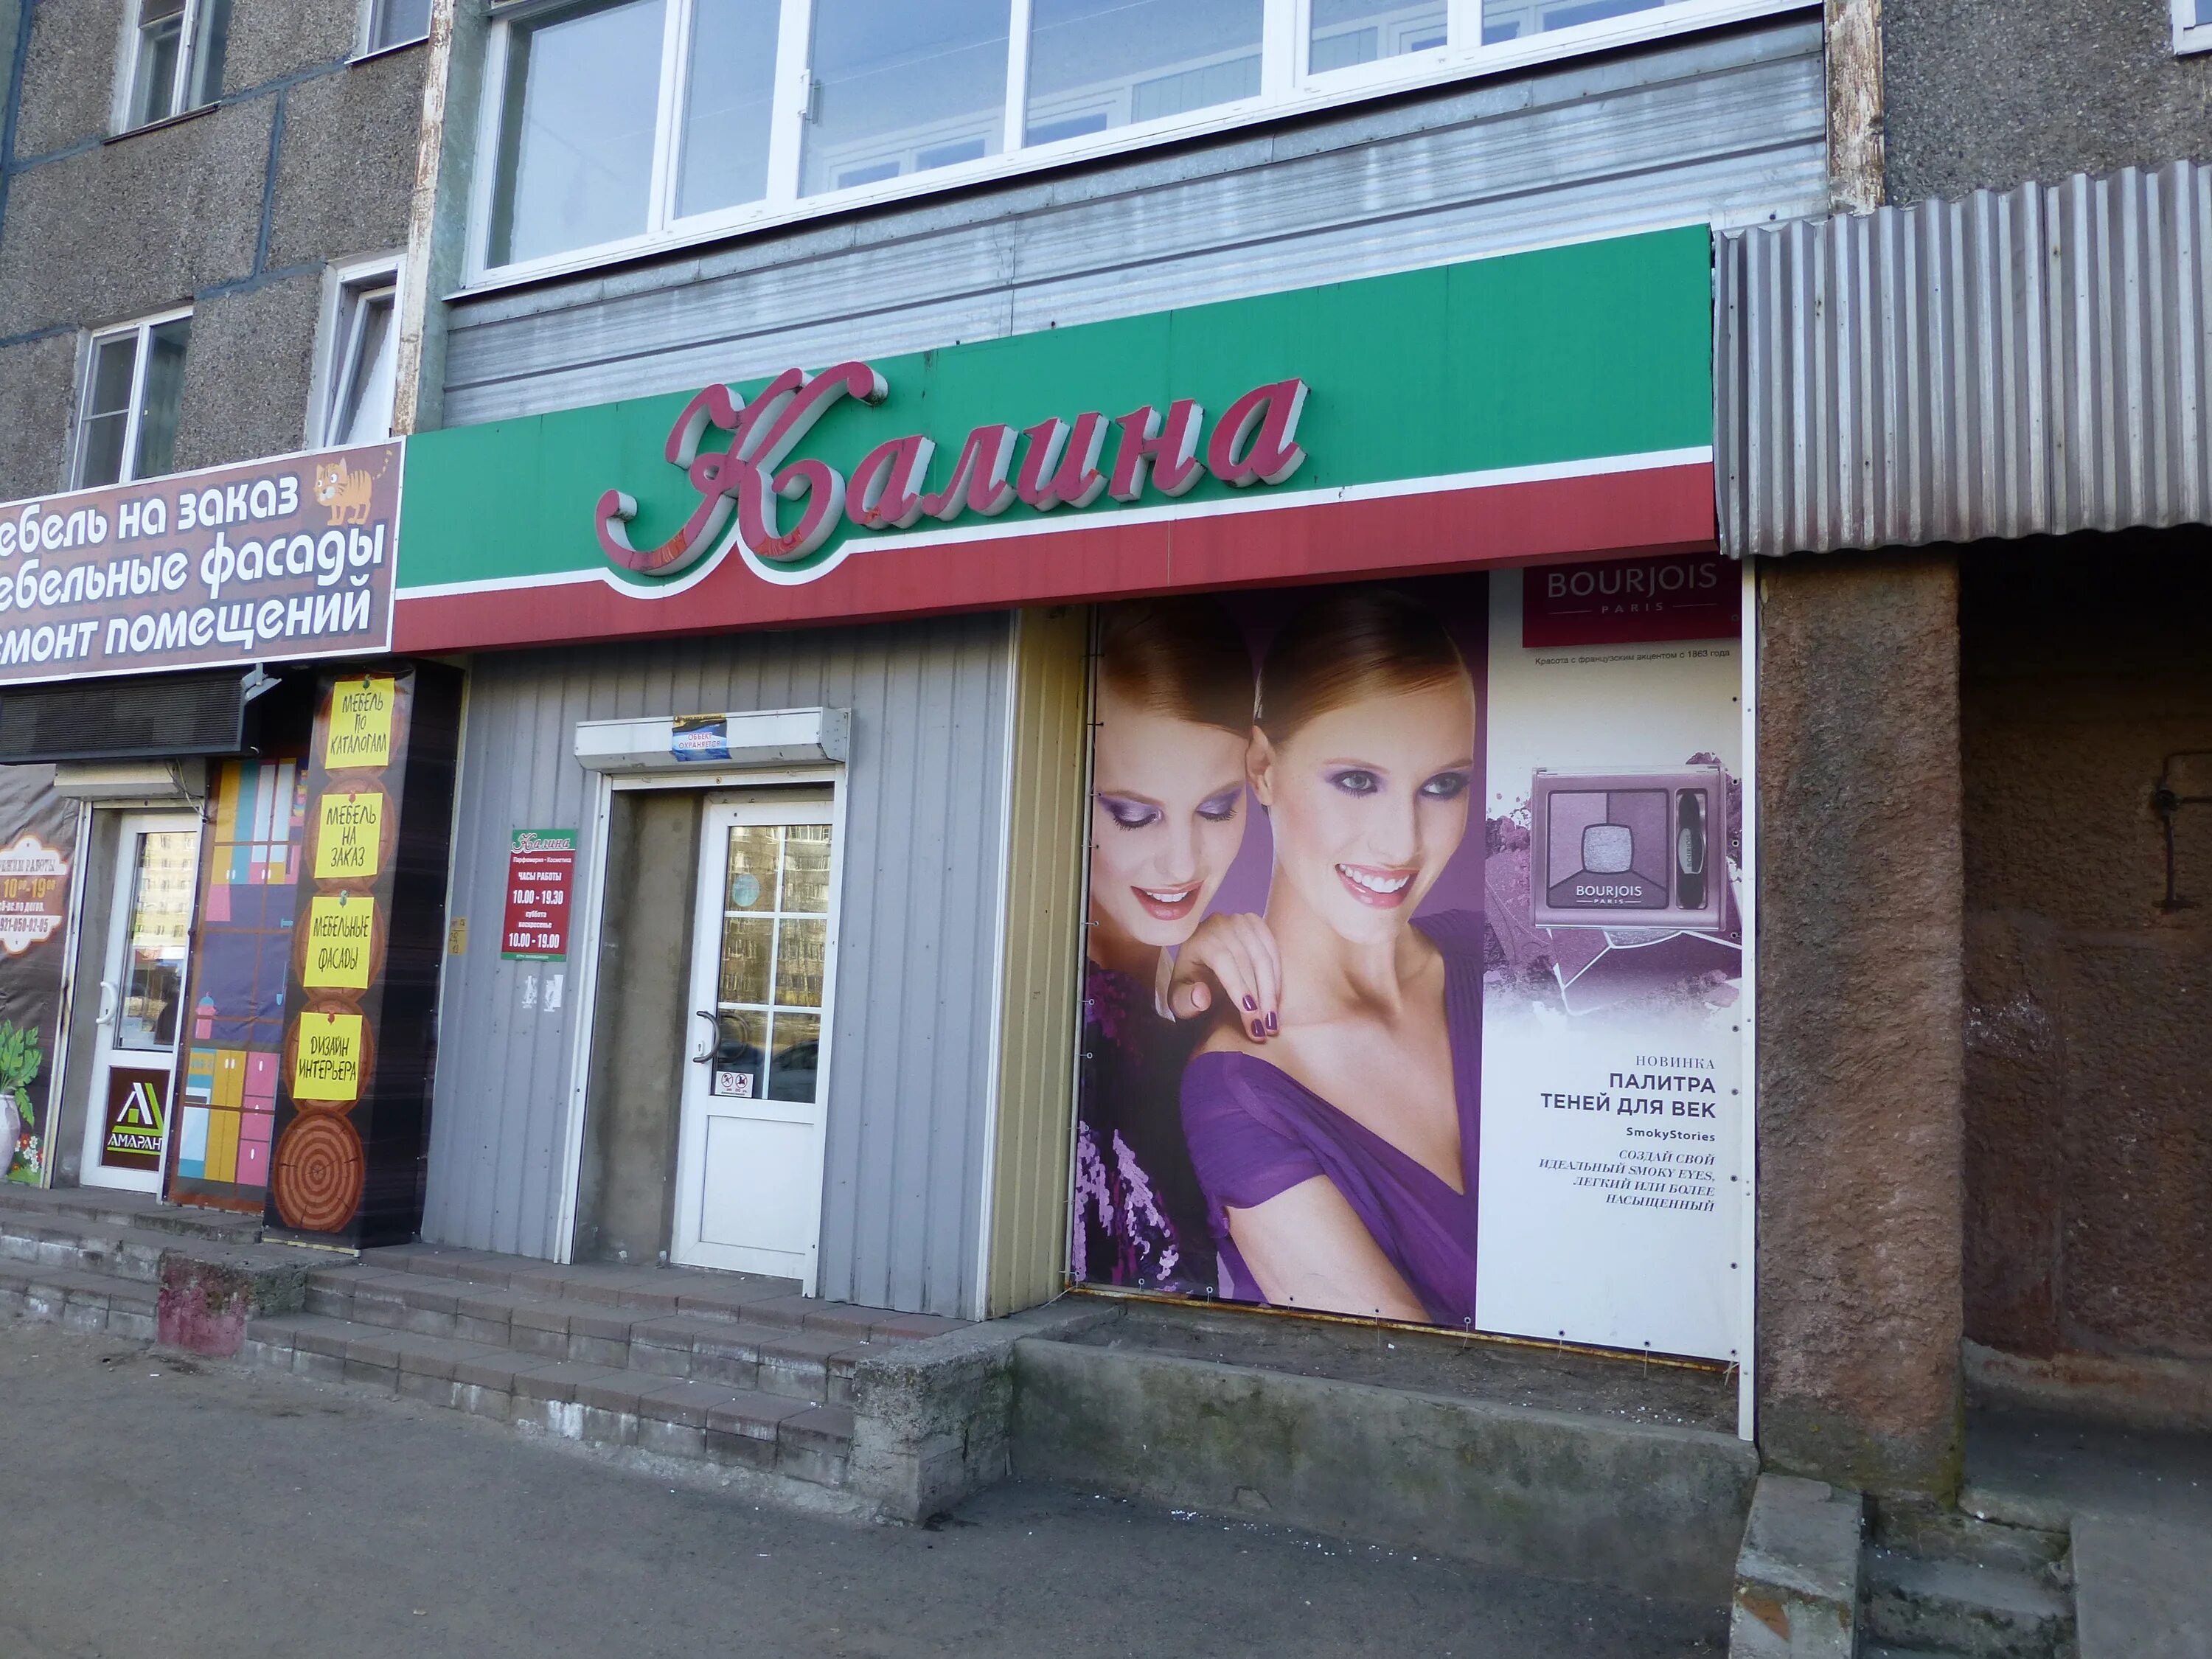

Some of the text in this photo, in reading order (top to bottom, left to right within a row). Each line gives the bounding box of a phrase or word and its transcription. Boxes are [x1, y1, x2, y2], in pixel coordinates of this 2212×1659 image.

[595, 361, 1308, 577] Калина
[118, 497, 167, 539] на
[177, 476, 299, 531] заказ
[201, 524, 385, 599] фасады
[1548, 563, 1717, 599] BOURJOIS
[1601, 602, 1663, 614] PARIS
[0, 574, 371, 665] монт помещений
[1535, 657, 1569, 666] Красота
[1636, 652, 1677, 661] акцентом
[1687, 650, 1708, 658] 1863
[1710, 649, 1730, 658] года
[342, 692, 383, 713] МЕБЕЛЬ
[354, 713, 366, 734] ПО
[330, 732, 387, 755] КАТАЛОГАМ
[678, 740, 720, 749] ОХРАНЯЕТСЯ
[326, 804, 376, 825] МЕБЕЛЬ
[341, 826, 356, 846] НА
[512, 833, 570, 853] Калина
[330, 846, 365, 867] ЗАКАЗ
[518, 872, 562, 881] ЧАСЫ РАБОТЫ
[513, 889, 535, 904] 10.00
[541, 890, 563, 905] 19.30
[1576, 886, 1643, 897] BOURJOIS
[313, 915, 370, 938] МЕБЕЛЬНЫЕ
[509, 933, 530, 947] 10.00
[538, 933, 560, 948] 19.00
[318, 947, 359, 972] ФАСАДЫ
[310, 1036, 350, 1057] ДИЗАЙН
[299, 1059, 357, 1081] ИНТЕРЬЕРА
[1635, 1055, 1716, 1069] НОВИНКА
[1609, 1072, 1717, 1093] ПАЛИТРА
[1540, 1092, 1717, 1119] ТЕНЕЙ ДЛЯ ВЕК
[107, 1133, 163, 1150] АМАРАН
[1626, 1127, 1716, 1142] SmokyStories
[1618, 1149, 1716, 1166] СОЗДАЙ СВОЙ
[1539, 1158, 1716, 1182] ИДЕАЛЬНЫЙ SMOKY EYES,
[1572, 1176, 1716, 1197] ЛЕГКИЙ ИЛИ БОЛЕЕ
[1605, 1193, 1715, 1212] НАСЫЩЕННЫЙ
